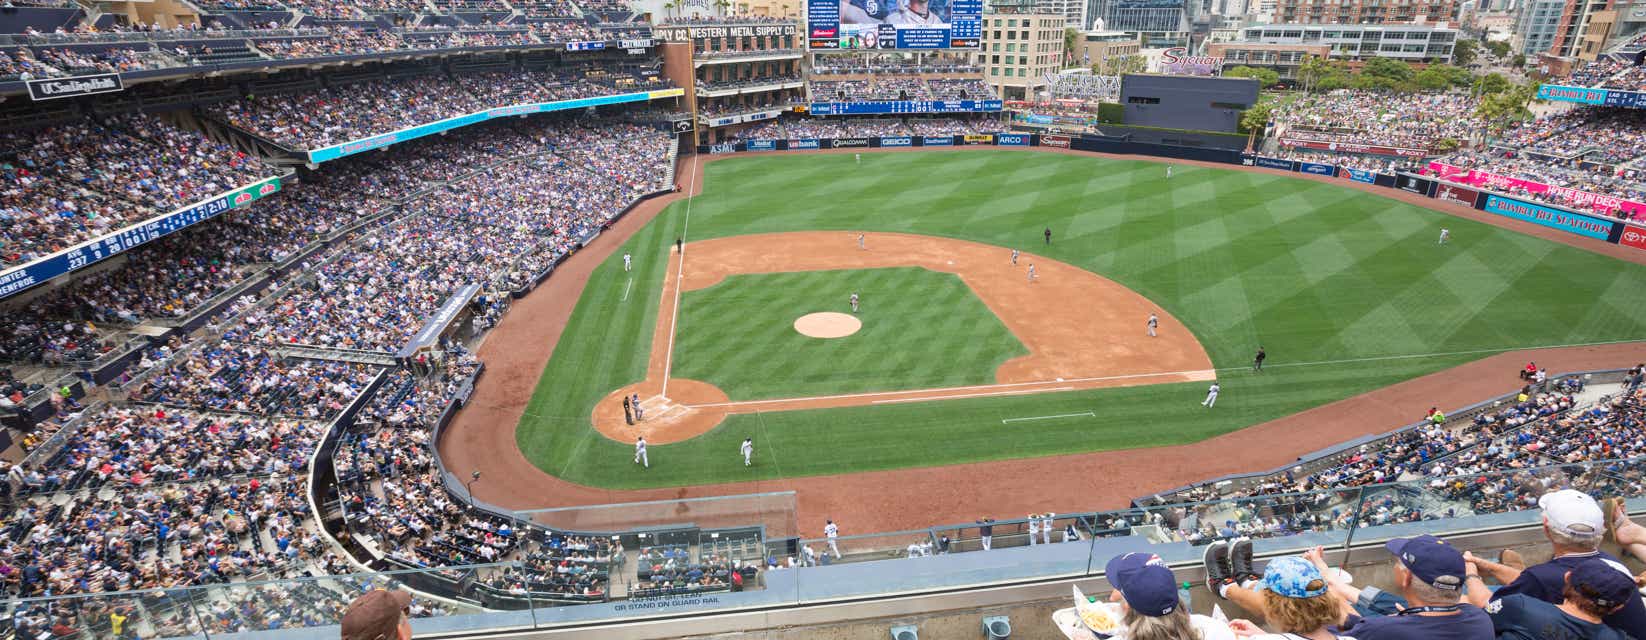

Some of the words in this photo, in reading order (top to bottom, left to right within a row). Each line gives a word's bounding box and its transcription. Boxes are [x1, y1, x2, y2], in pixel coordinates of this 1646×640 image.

[689, 27, 727, 39] WESTERN
[730, 27, 755, 37] METAL
[756, 26, 783, 36] SUPPLY
[784, 26, 796, 35] CO.
[1161, 47, 1224, 68] Sycuan
[1550, 87, 1584, 99] BUMBLE
[1586, 92, 1603, 101] BEE
[833, 139, 867, 147] QUALCOMM
[882, 138, 910, 146] GEICO
[999, 136, 1021, 144] ARCO
[710, 144, 735, 153] ASML
[1405, 150, 1425, 158] ROXY
[1547, 185, 1574, 200] HOME
[1574, 190, 1596, 205] RUN
[1596, 196, 1622, 209] DECK
[1498, 200, 1536, 218] BUMBLE
[1536, 210, 1554, 221] BEE
[1556, 214, 1612, 236] SEAFOODS
[67, 249, 83, 260] AVG
[67, 255, 87, 270] .237
[0, 269, 27, 285] UNTER
[628, 602, 656, 610] STAND
[657, 600, 670, 608] ON
[672, 598, 700, 606] GUARD
